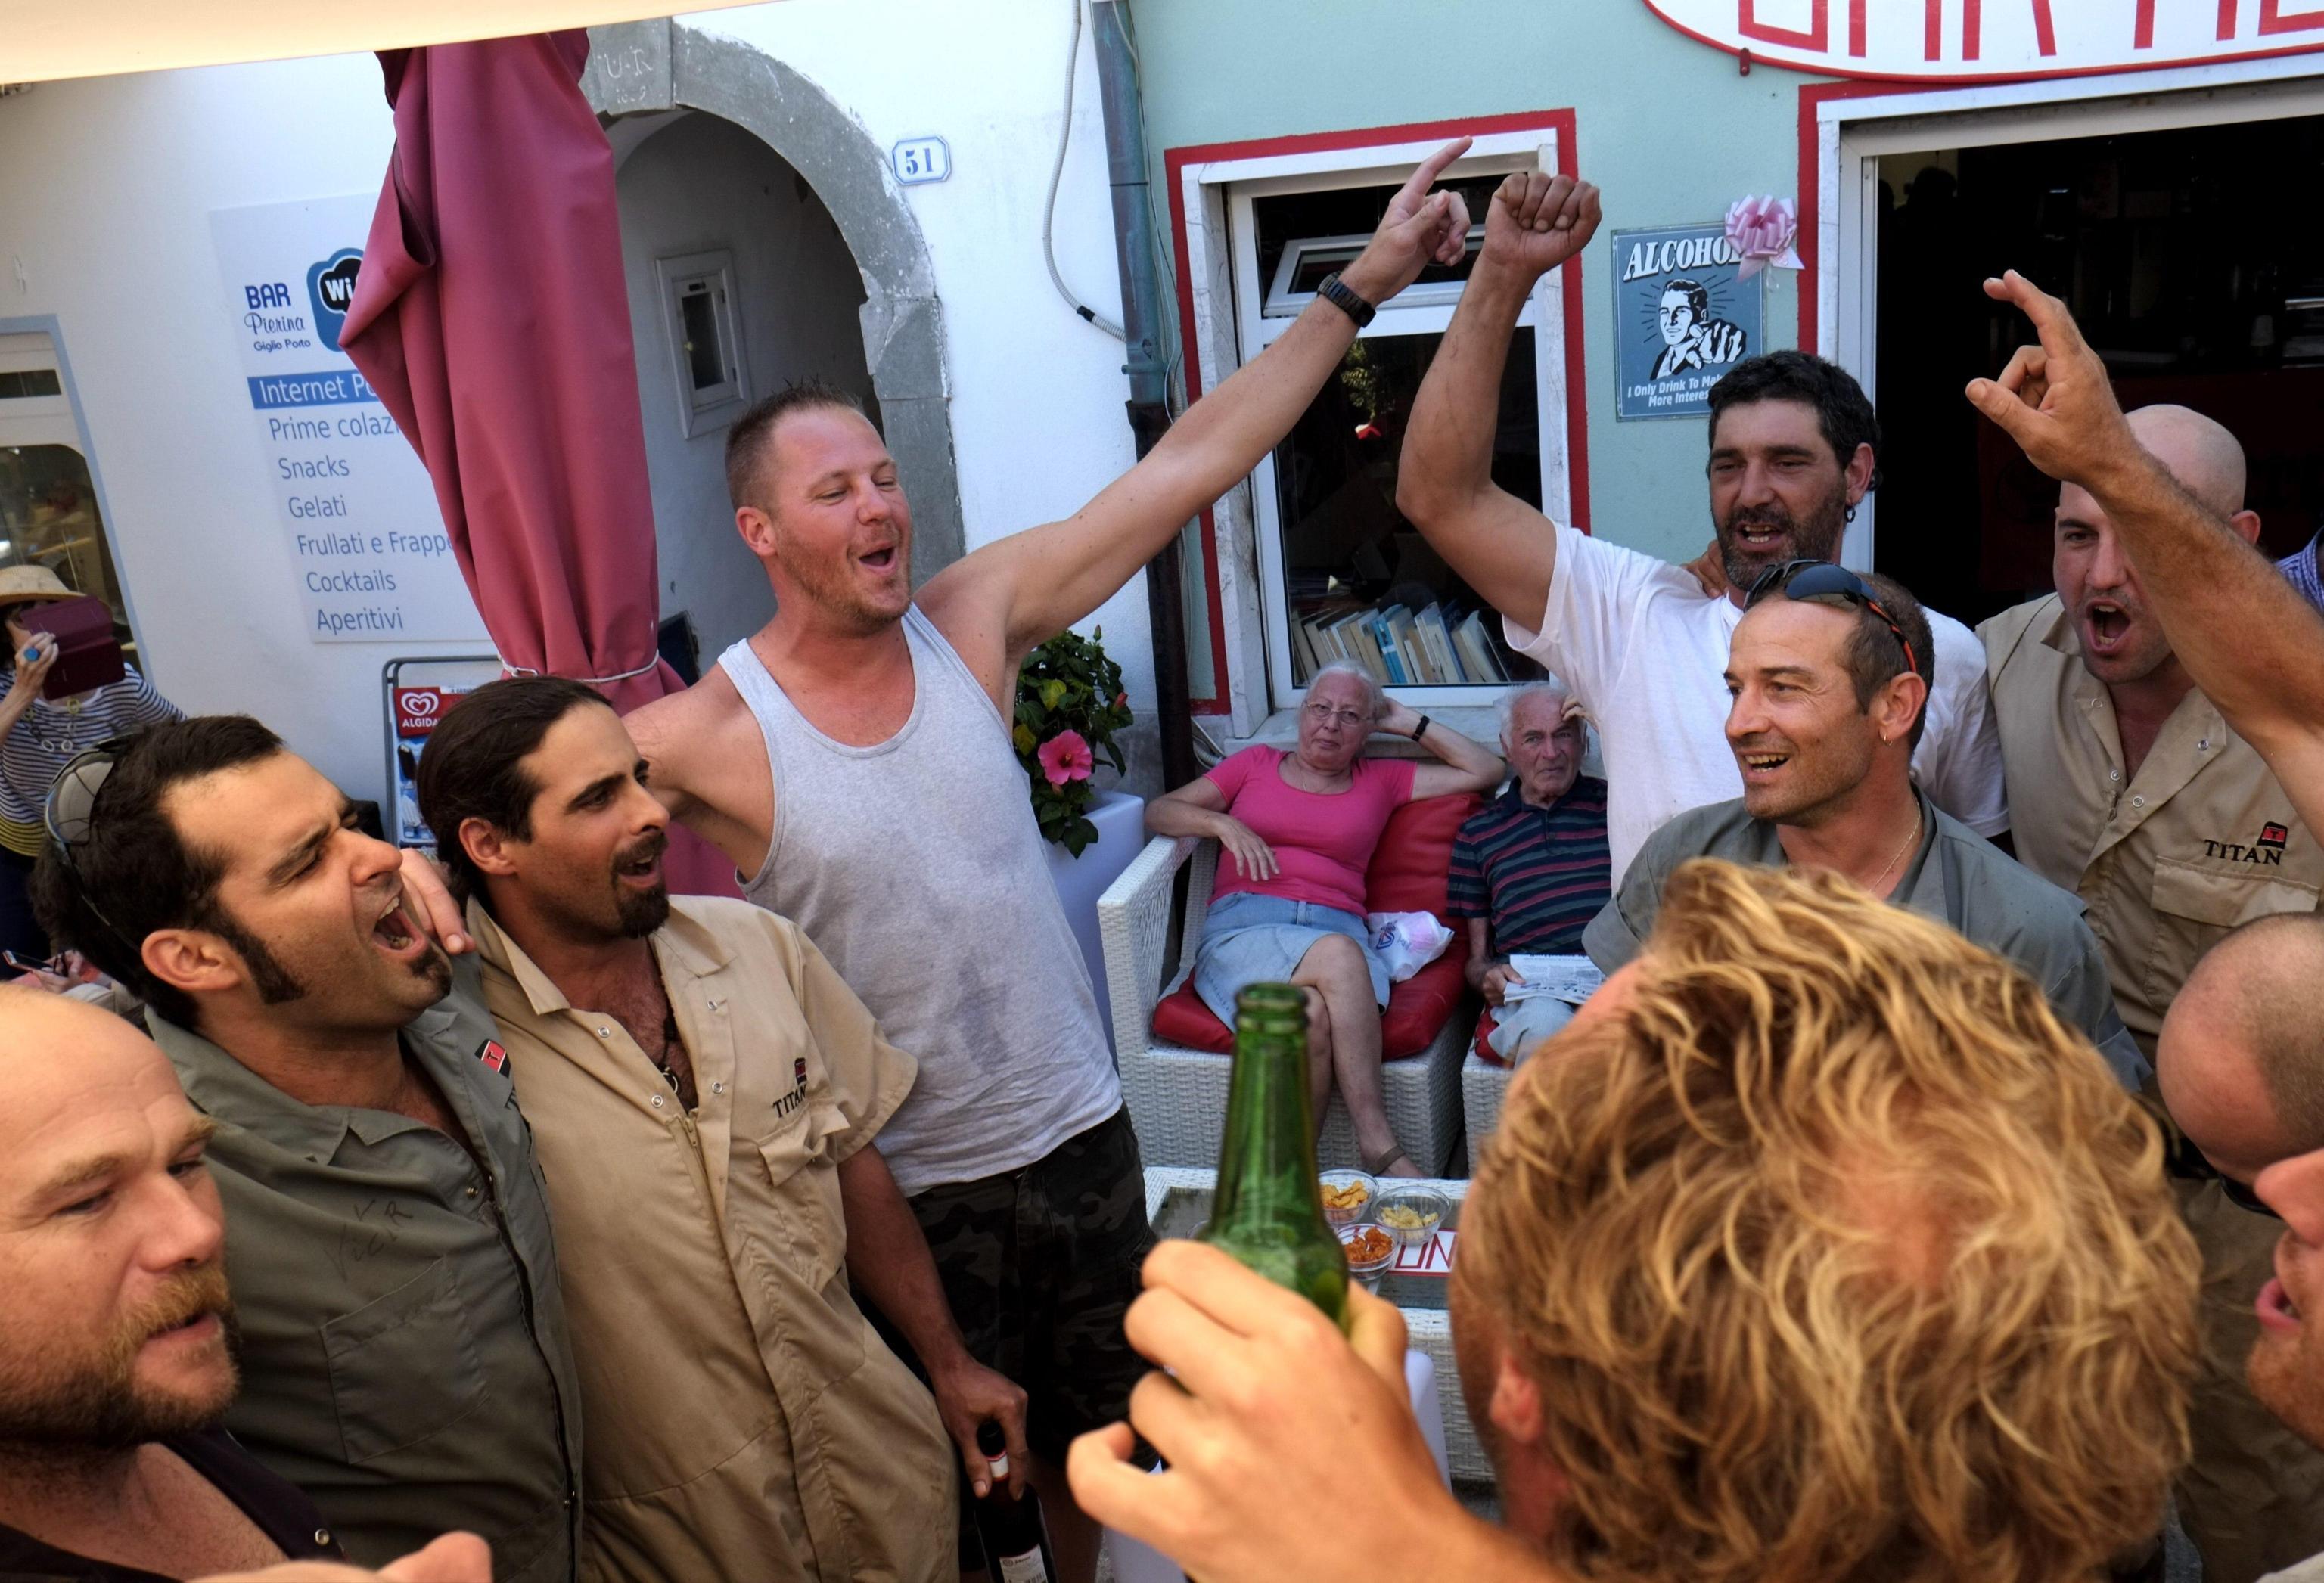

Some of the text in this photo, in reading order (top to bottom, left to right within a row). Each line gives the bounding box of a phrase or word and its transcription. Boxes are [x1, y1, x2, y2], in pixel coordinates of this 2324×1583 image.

[905, 147, 934, 175] 51
[244, 282, 291, 310] BAR
[244, 312, 306, 335] Pierina
[253, 338, 311, 354] Giglio Porto
[259, 375, 347, 404] Internet
[1633, 383, 1657, 398] Only
[1658, 378, 1687, 394] Drink
[1689, 377, 1698, 390] To
[1648, 393, 1673, 407] More
[269, 416, 331, 441] Prime
[278, 454, 350, 480] Snacks
[288, 495, 348, 518] Gelati
[297, 533, 365, 556] Frullati
[371, 536, 384, 554] e
[306, 570, 396, 593] Cocktails
[318, 607, 404, 635] Aperitivi
[402, 717, 439, 728] ALGIDA
[2204, 839, 2283, 865] TITAN
[772, 1083, 807, 1118] TITAN
